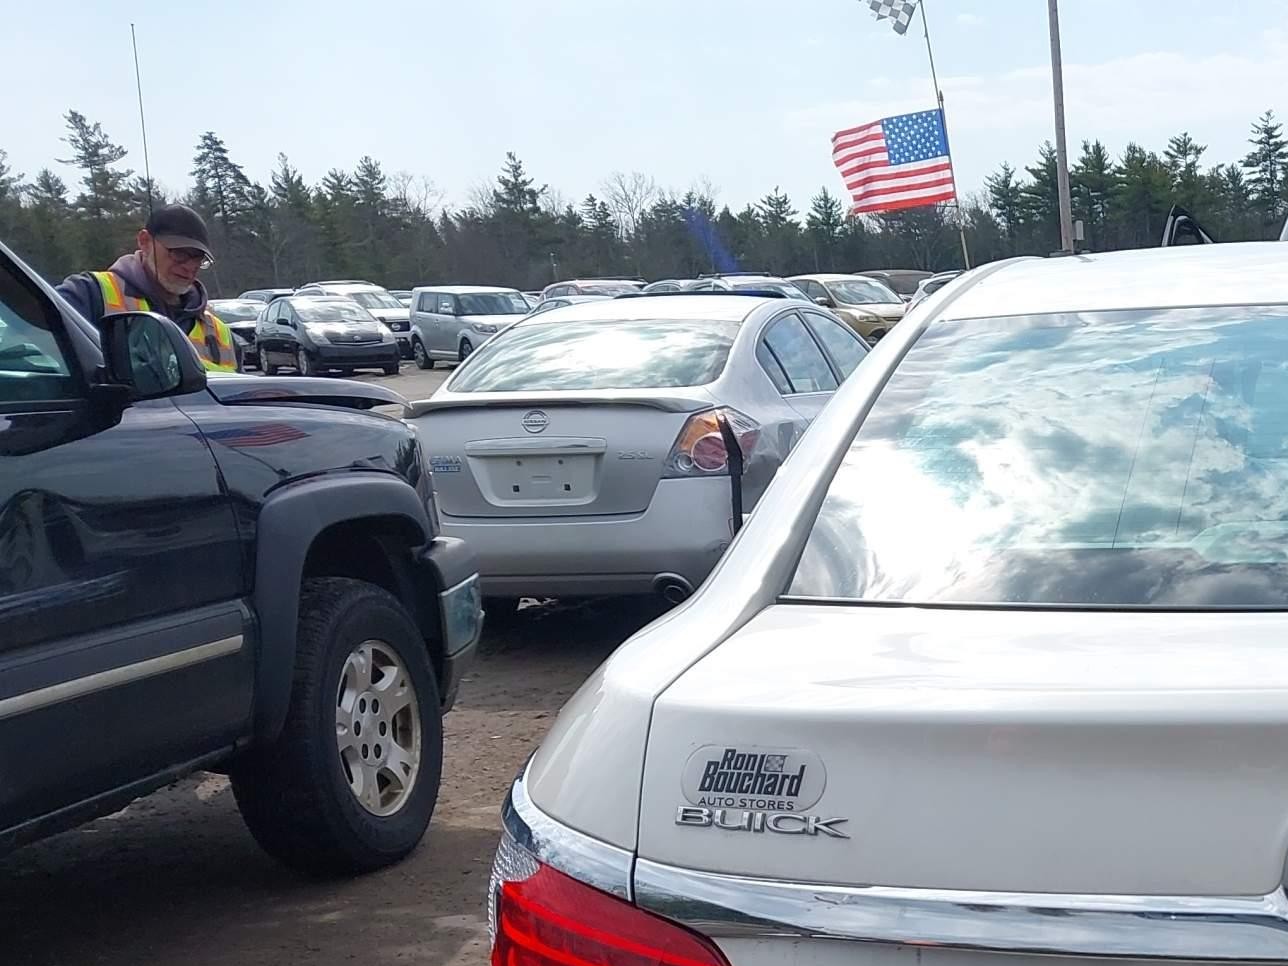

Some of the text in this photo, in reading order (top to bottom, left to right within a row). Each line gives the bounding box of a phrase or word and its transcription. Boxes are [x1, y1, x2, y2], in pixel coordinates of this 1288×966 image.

[719, 748, 754, 771] Ron
[698, 753, 806, 797] Bouchard
[698, 796, 794, 811] AUTO STORES
[675, 805, 851, 839] BUICK
